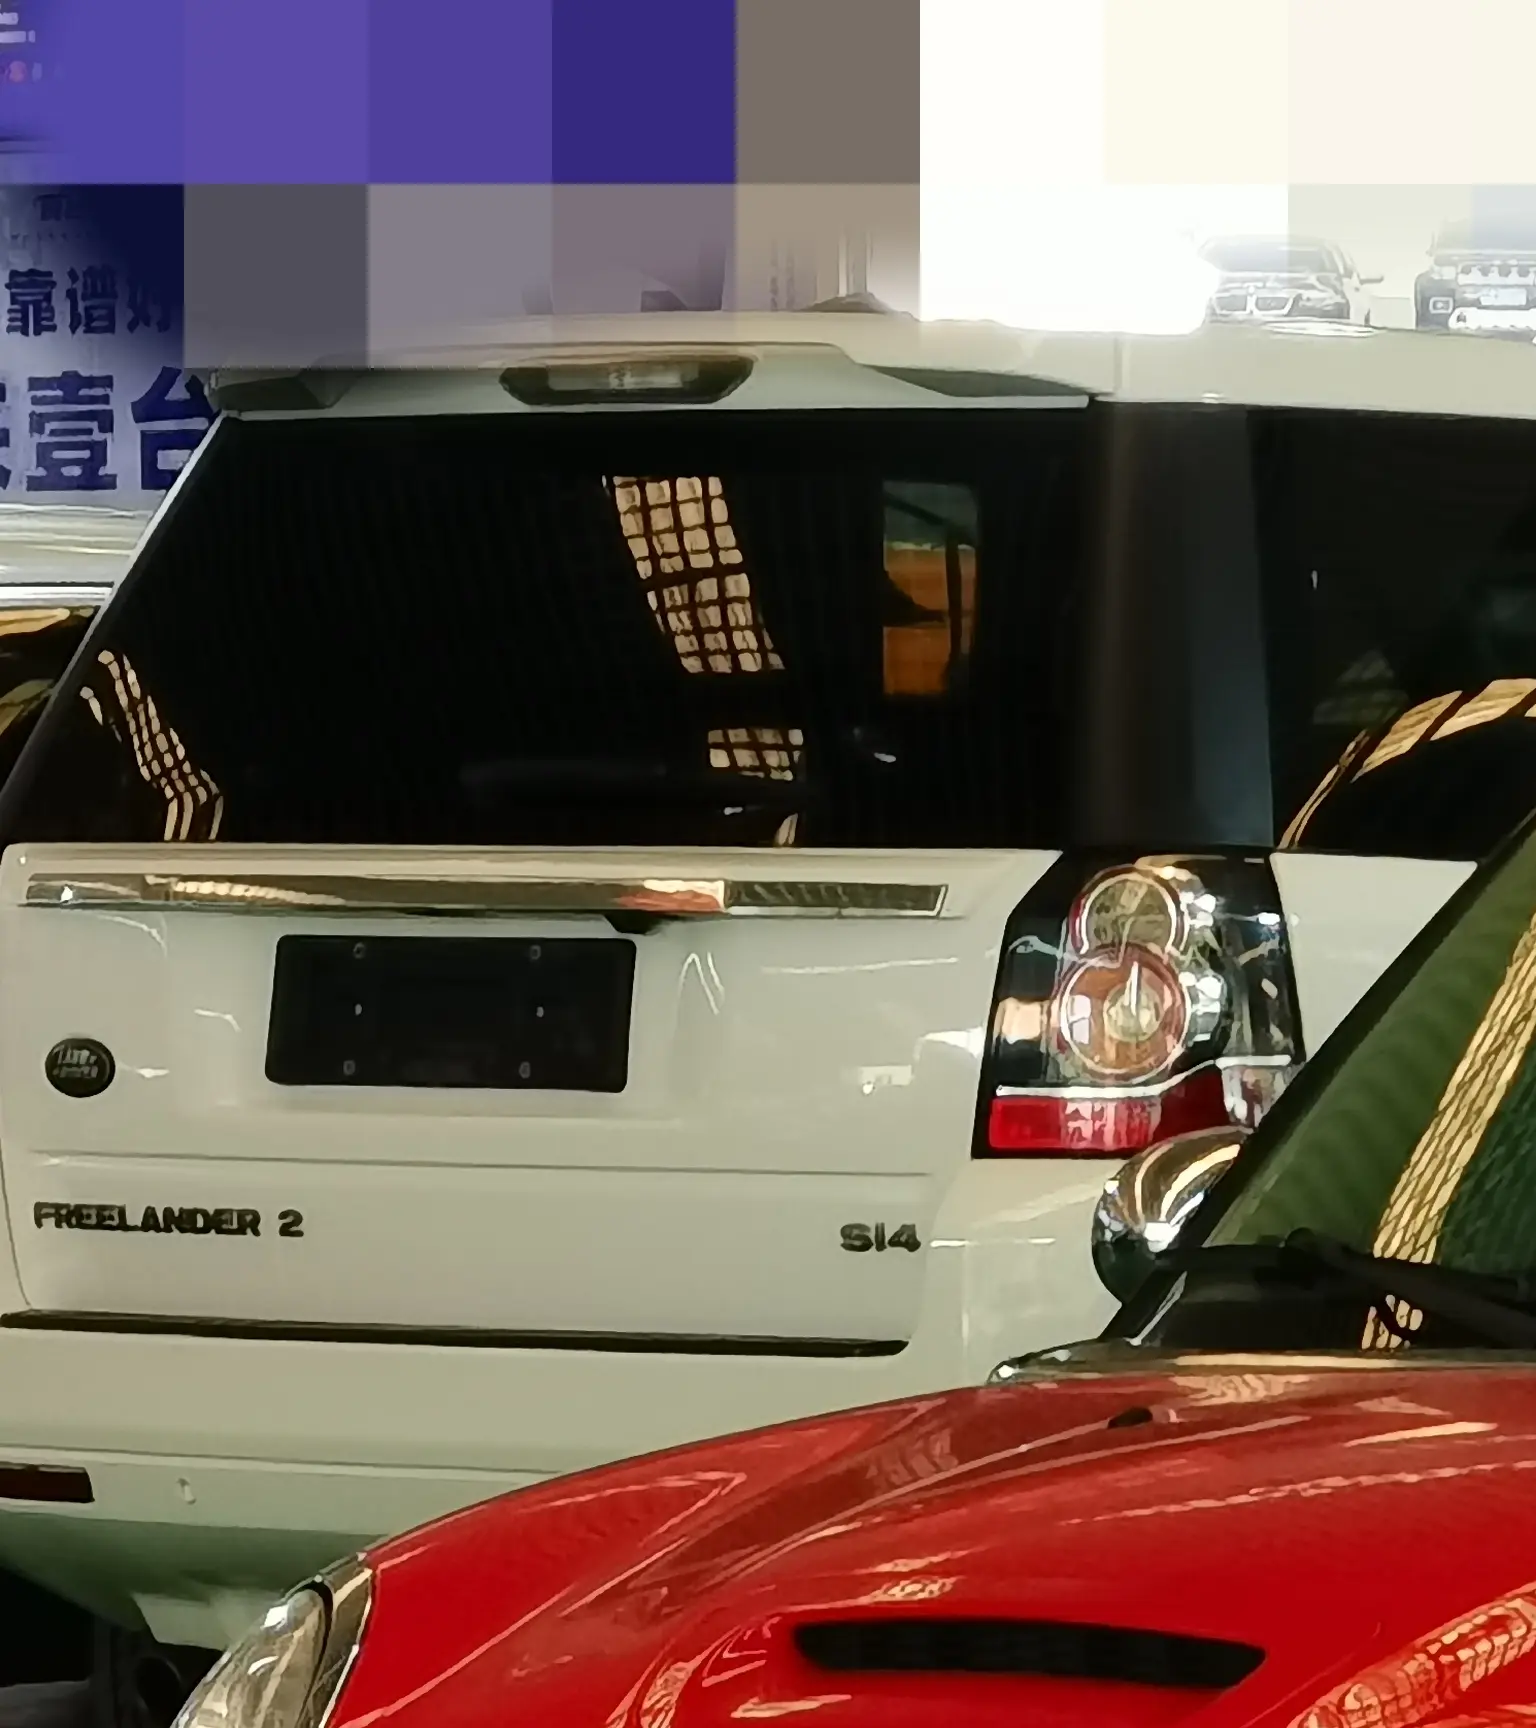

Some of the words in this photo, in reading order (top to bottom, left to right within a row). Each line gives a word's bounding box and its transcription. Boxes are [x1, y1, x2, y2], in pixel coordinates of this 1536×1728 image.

[0, 366, 213, 492] 壹台
[34, 1201, 261, 1237] FREELANDER
[278, 1209, 304, 1238] 2
